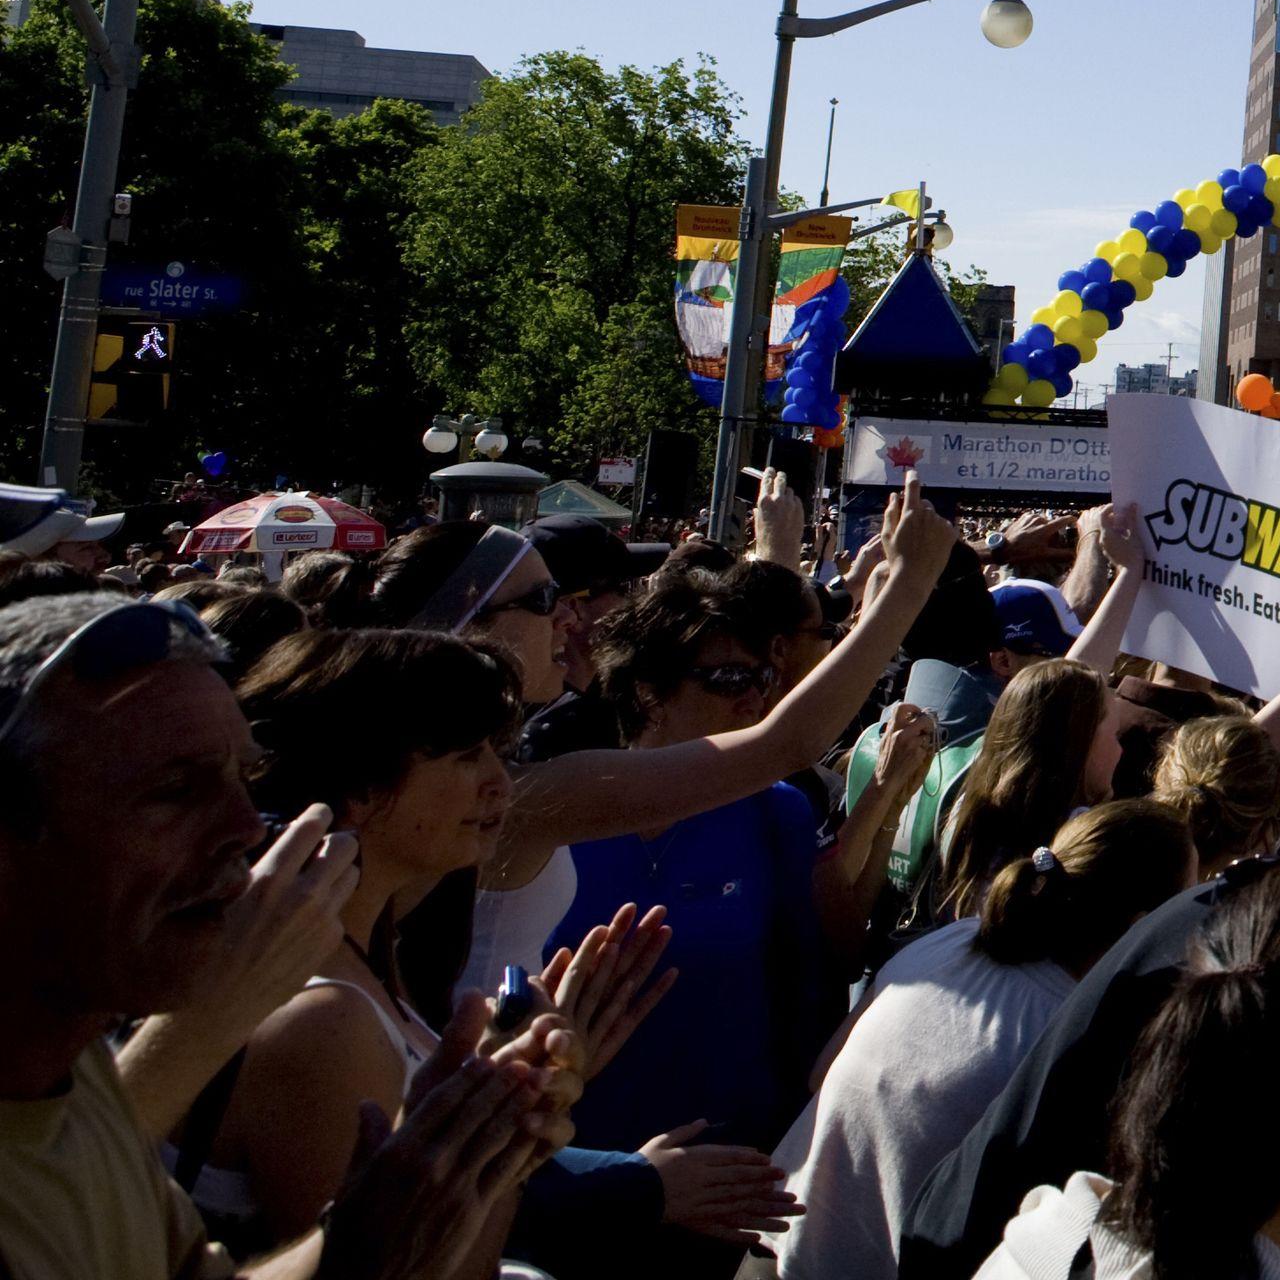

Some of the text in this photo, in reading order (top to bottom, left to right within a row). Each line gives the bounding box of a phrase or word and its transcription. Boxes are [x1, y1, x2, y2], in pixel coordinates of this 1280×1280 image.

[124, 280, 218, 299] rue Slater St.
[944, 433, 1043, 454] Marathon
[957, 466, 978, 478] et
[987, 462, 1021, 480] 1/2
[1197, 574, 1249, 612] fresh.
[1252, 593, 1280, 624] Eat
